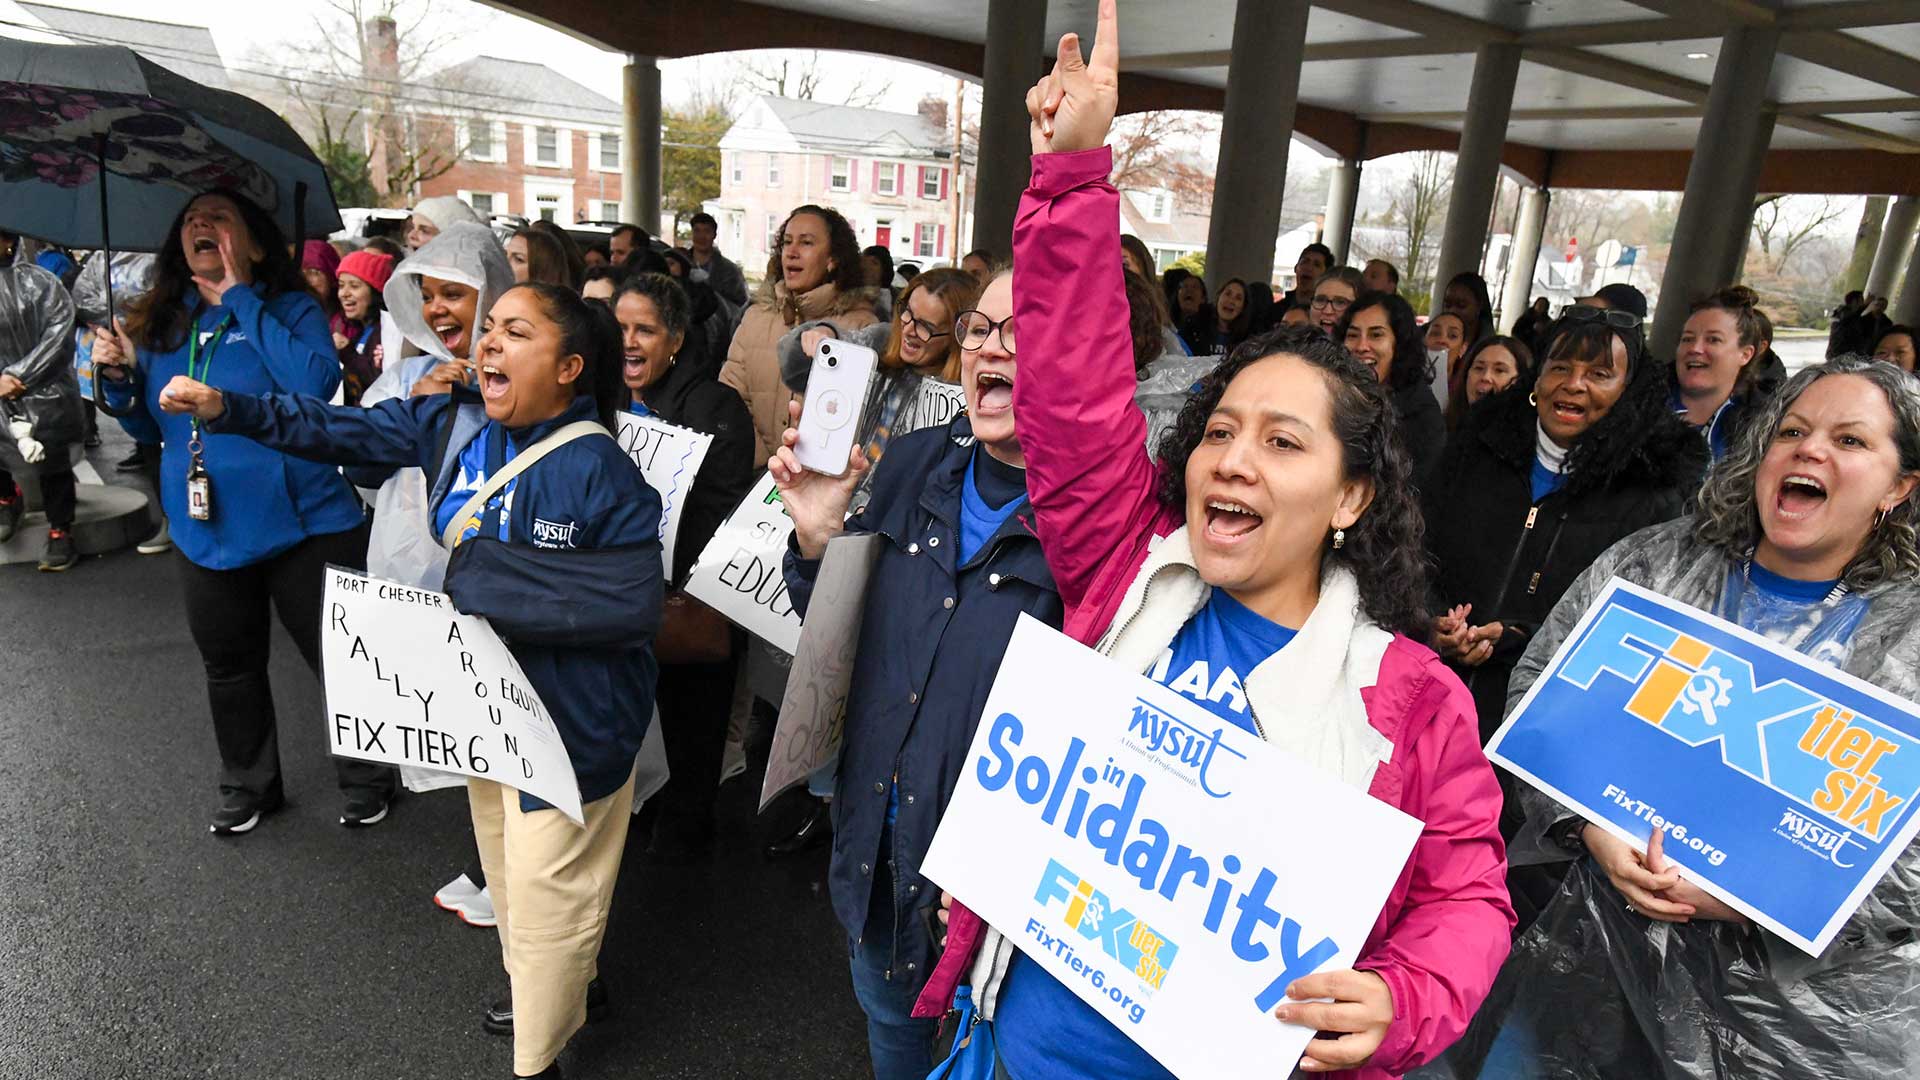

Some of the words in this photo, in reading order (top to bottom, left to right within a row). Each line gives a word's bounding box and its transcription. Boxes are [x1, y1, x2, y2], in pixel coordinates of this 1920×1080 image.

[533, 518, 579, 548] nysut
[336, 575, 369, 594] PORT
[379, 585, 442, 608] CHESTER
[335, 713, 386, 754] FIX
[396, 725, 462, 768] TIER
[468, 735, 490, 773] 6
[1128, 696, 1247, 798] nysut
[1799, 704, 1900, 779] tier
[1102, 757, 1125, 788] in
[1602, 784, 1727, 866] FixTier6.org
[1811, 770, 1903, 838] six
[976, 712, 1340, 1014] Solidarity
[1779, 807, 1867, 868] nysut
[1129, 919, 1165, 958] tier
[1025, 917, 1146, 1024] FixTier6.org
[1136, 956, 1167, 991] six
